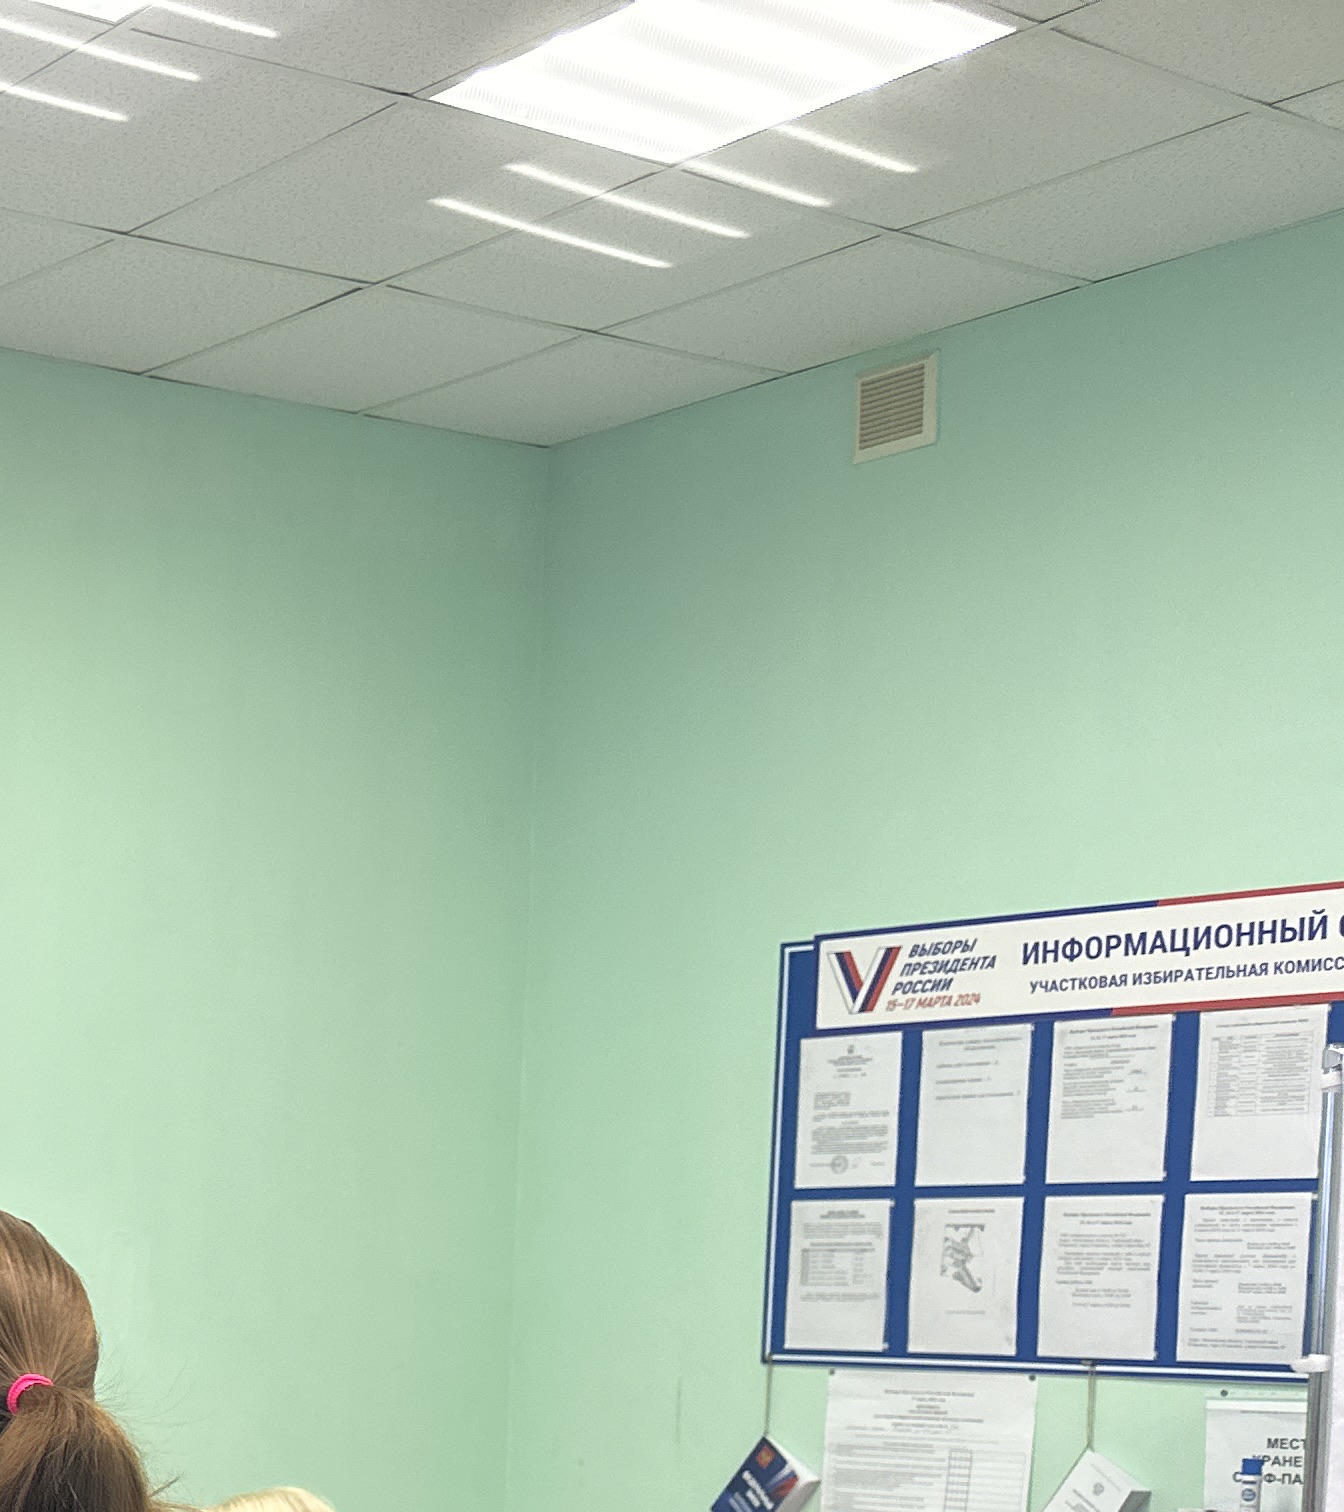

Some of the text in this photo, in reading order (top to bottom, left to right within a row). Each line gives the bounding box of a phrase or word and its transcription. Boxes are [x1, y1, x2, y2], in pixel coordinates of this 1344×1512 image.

[1022, 908, 1329, 966] ИНФОРМАЦИОННЫЙ
[908, 938, 978, 958] ВЫБОРЫ
[900, 954, 997, 977] ПРЕЗИДЕНТА
[892, 978, 954, 995] РОССИИ
[1029, 973, 1128, 995] УЧАСТКОВАЯ
[1132, 962, 1269, 986] ИЗБИРАТЕЛЬНАЯ
[915, 995, 952, 1009] МАРТА
[953, 993, 981, 1007] 2024
[1253, 1455, 1303, 1468] РАНЕ
